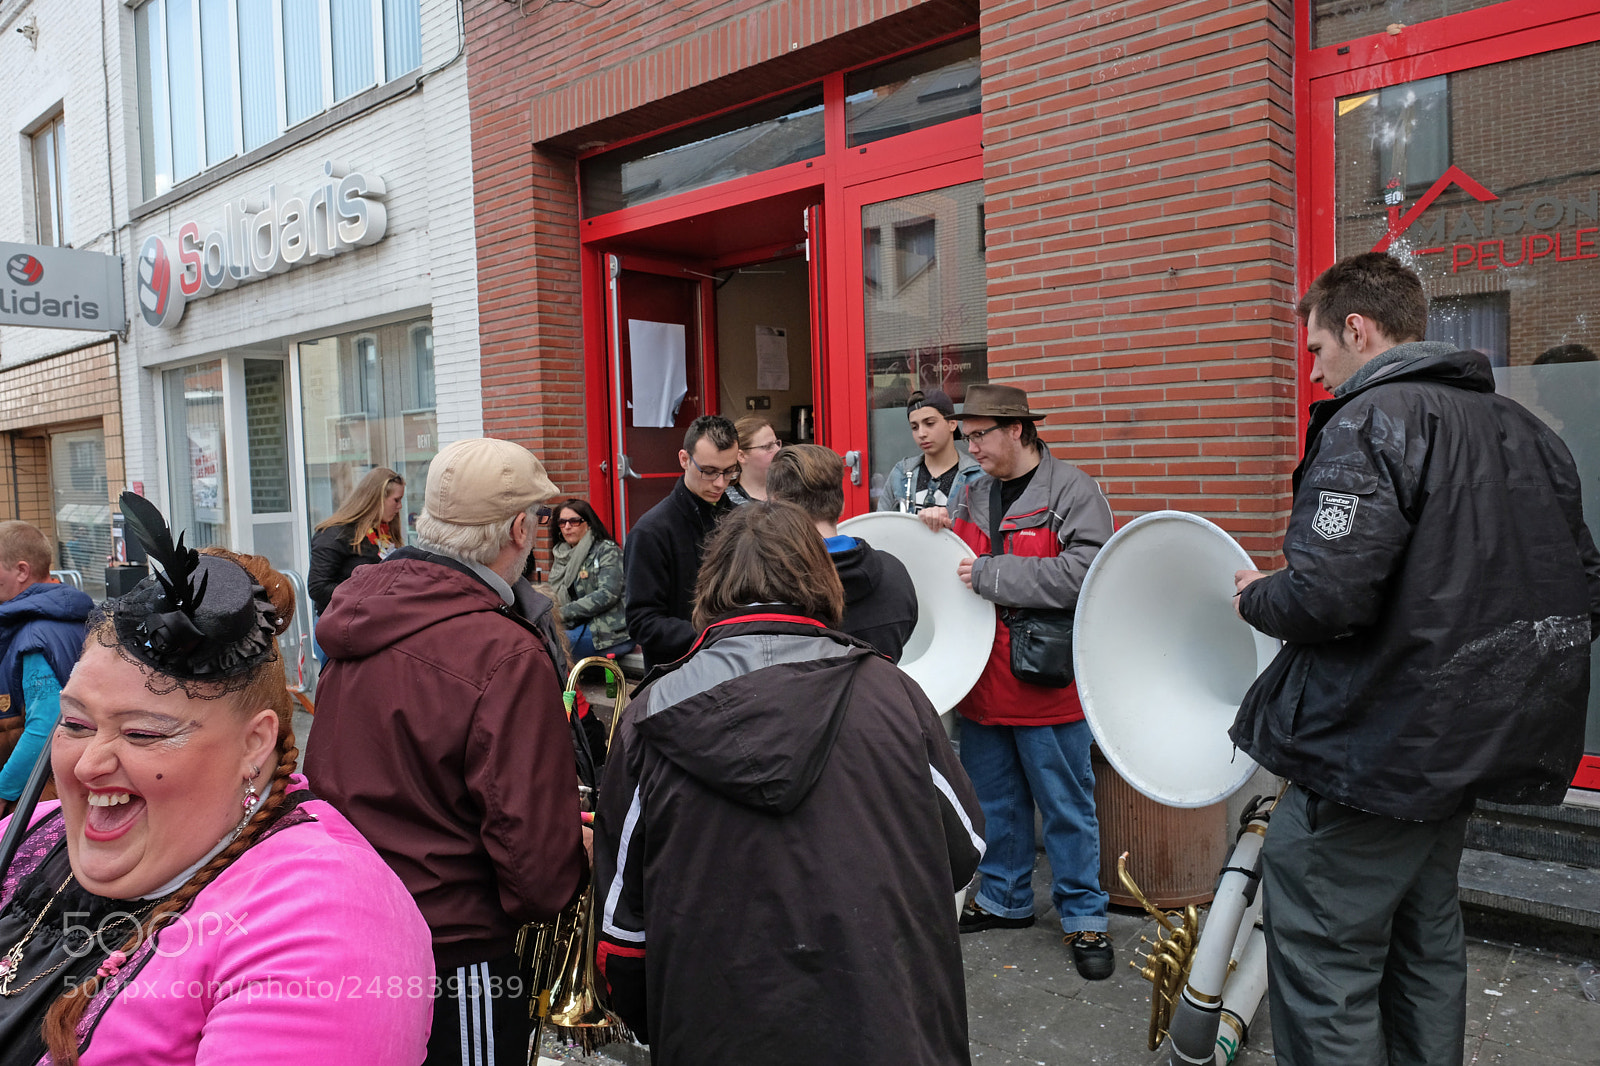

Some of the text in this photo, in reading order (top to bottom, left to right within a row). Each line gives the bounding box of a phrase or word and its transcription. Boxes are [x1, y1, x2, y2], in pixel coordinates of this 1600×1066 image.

[178, 159, 380, 297] Solidaris
[1406, 187, 1599, 246] MAISON
[1452, 227, 1599, 274] PEUPLE
[0, 288, 99, 320] lidaris
